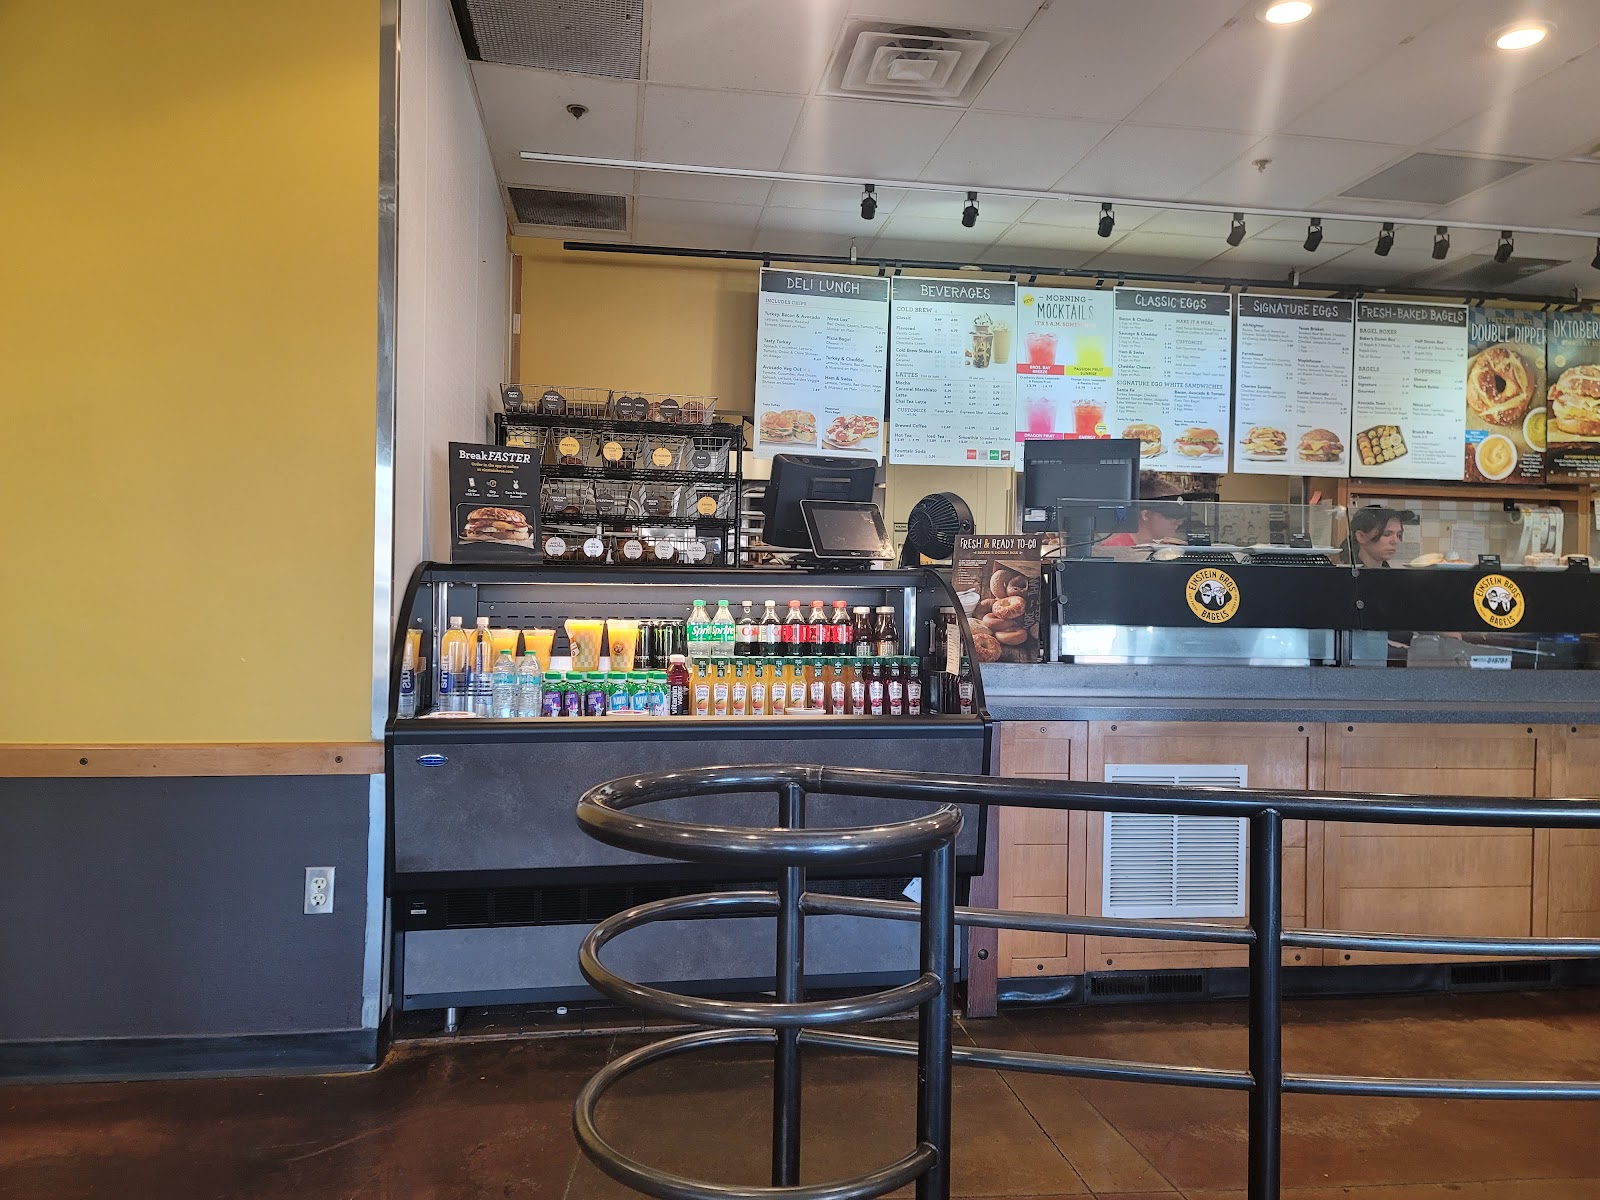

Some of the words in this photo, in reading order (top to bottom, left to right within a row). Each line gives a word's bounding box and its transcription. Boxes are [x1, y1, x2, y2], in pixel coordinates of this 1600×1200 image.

[787, 277, 813, 291] DELI
[819, 280, 860, 294] LUNCH
[920, 284, 990, 299] BEVERAGES
[1046, 294, 1086, 303] MORNING
[1135, 294, 1177, 308] CLASSIC
[1180, 298, 1207, 310] EGGS
[1037, 303, 1094, 320] MOCKTAILS
[1254, 300, 1309, 316] SIGNATURE
[1313, 305, 1338, 318] EGGS
[1361, 305, 1428, 321] FRESH-BAKED
[1431, 309, 1464, 323] BAGELS
[1472, 324, 1510, 342] DOUBLE
[459, 450, 530, 463] BreakFASTER
[960, 538, 982, 550] FRESH
[983, 538, 991, 548] &
[992, 538, 1015, 549] READY
[1017, 539, 1037, 550] TO-GO
[1189, 570, 1217, 591] EINSTEIN
[1219, 573, 1236, 592] BROS
[1476, 577, 1502, 597] EINSTEIN
[1504, 580, 1521, 598] BROS
[1201, 609, 1229, 620] BAGELS
[1489, 615, 1515, 626] BAGELS
[711, 626, 734, 638] Sprite
